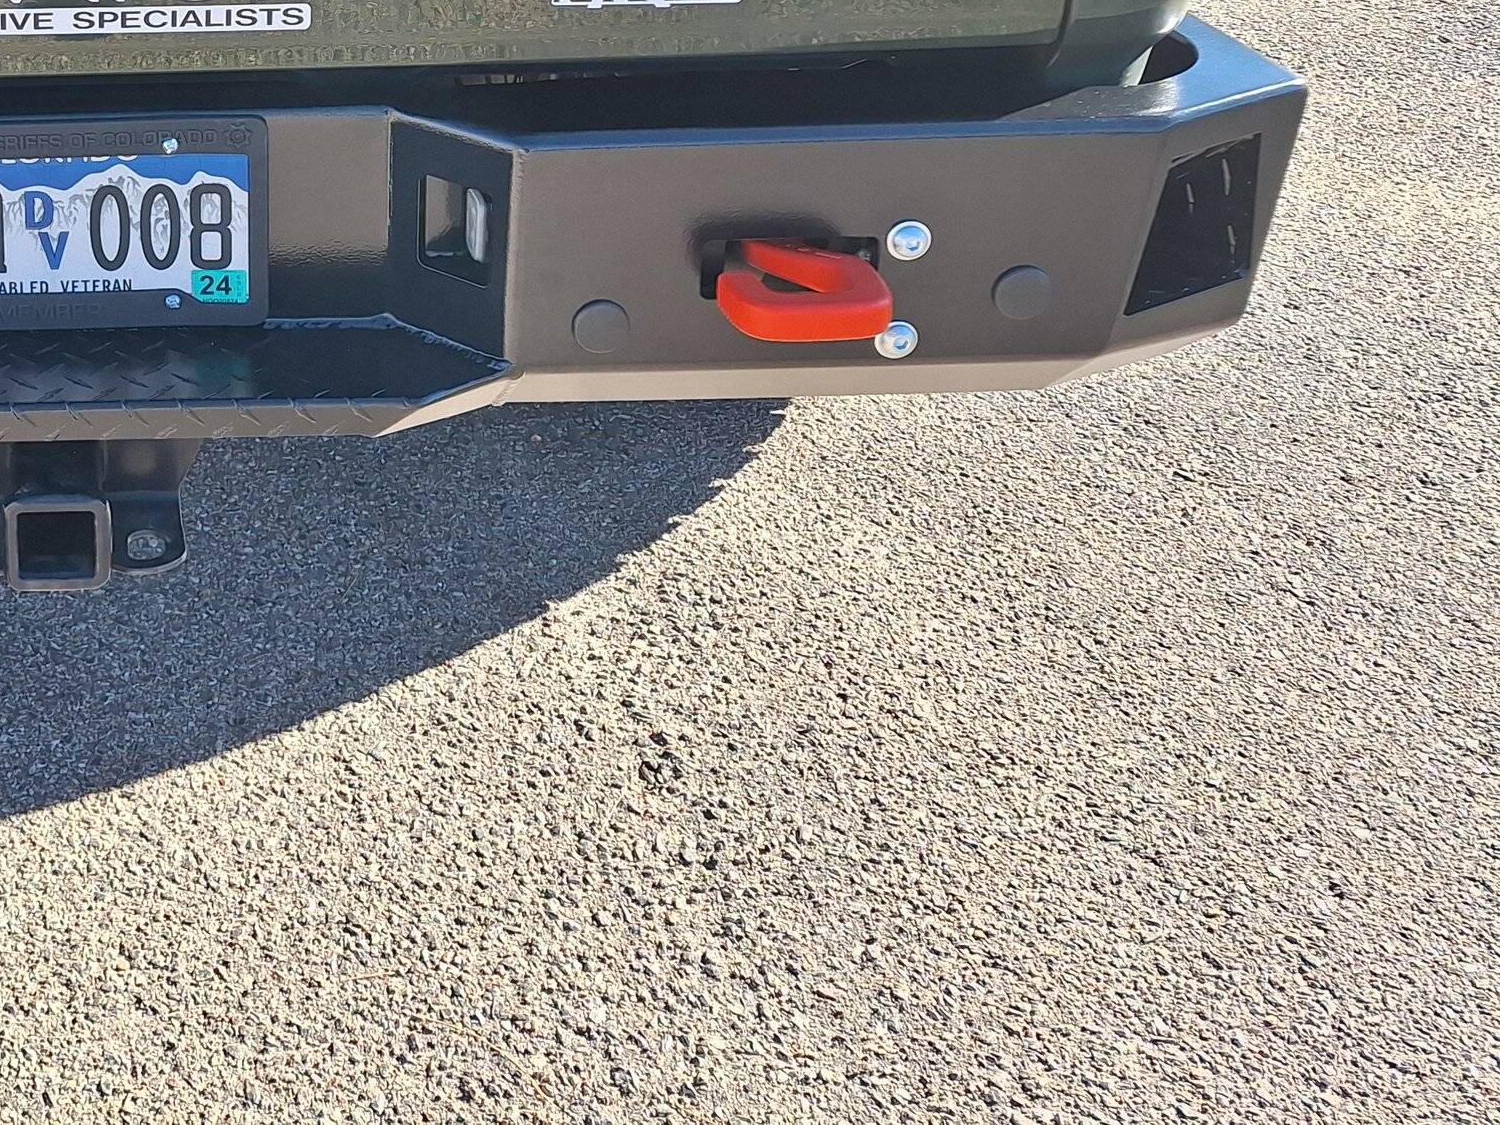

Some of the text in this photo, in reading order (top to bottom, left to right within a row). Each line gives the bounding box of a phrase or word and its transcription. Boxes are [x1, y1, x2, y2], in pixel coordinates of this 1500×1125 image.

[72, 7, 306, 31] SPECIALISTS
[68, 132, 98, 148] OF
[92, 183, 234, 272] 008
[60, 278, 133, 293] VETERAN
[200, 274, 232, 296] 24
